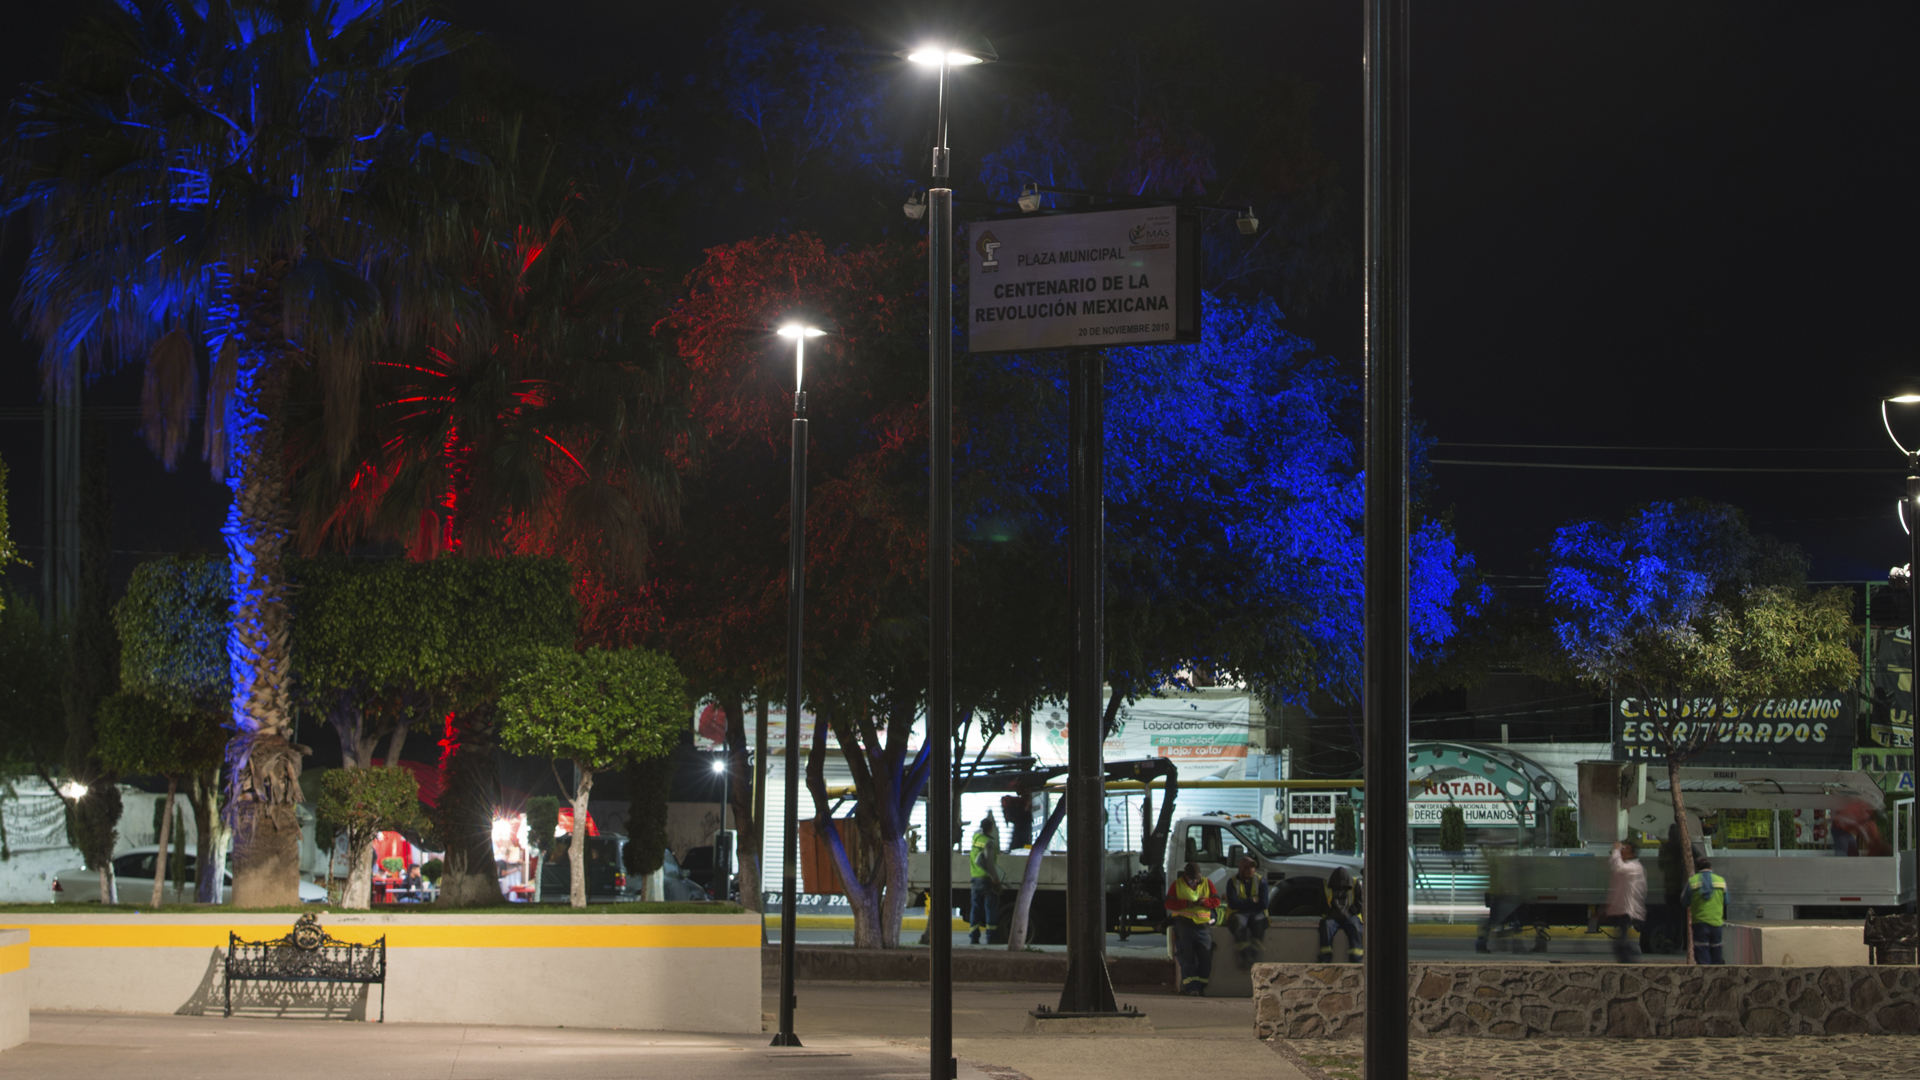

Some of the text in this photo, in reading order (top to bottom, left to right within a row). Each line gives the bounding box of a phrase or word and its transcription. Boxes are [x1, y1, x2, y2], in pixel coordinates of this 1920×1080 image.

[1017, 247, 1125, 267] PLAZA MUNICIPAL
[993, 273, 1149, 299] CENTENARIO DE LA
[975, 295, 1169, 323] REVOLUCIÓN MEXICANA
[1078, 322, 1170, 337] 20 DE NOVIEMBRE 2010
[1143, 721, 1204, 731] Laboratorio
[1622, 721, 1829, 743] ESCRITURADOS
[1465, 810, 1514, 820] HUMANOS
